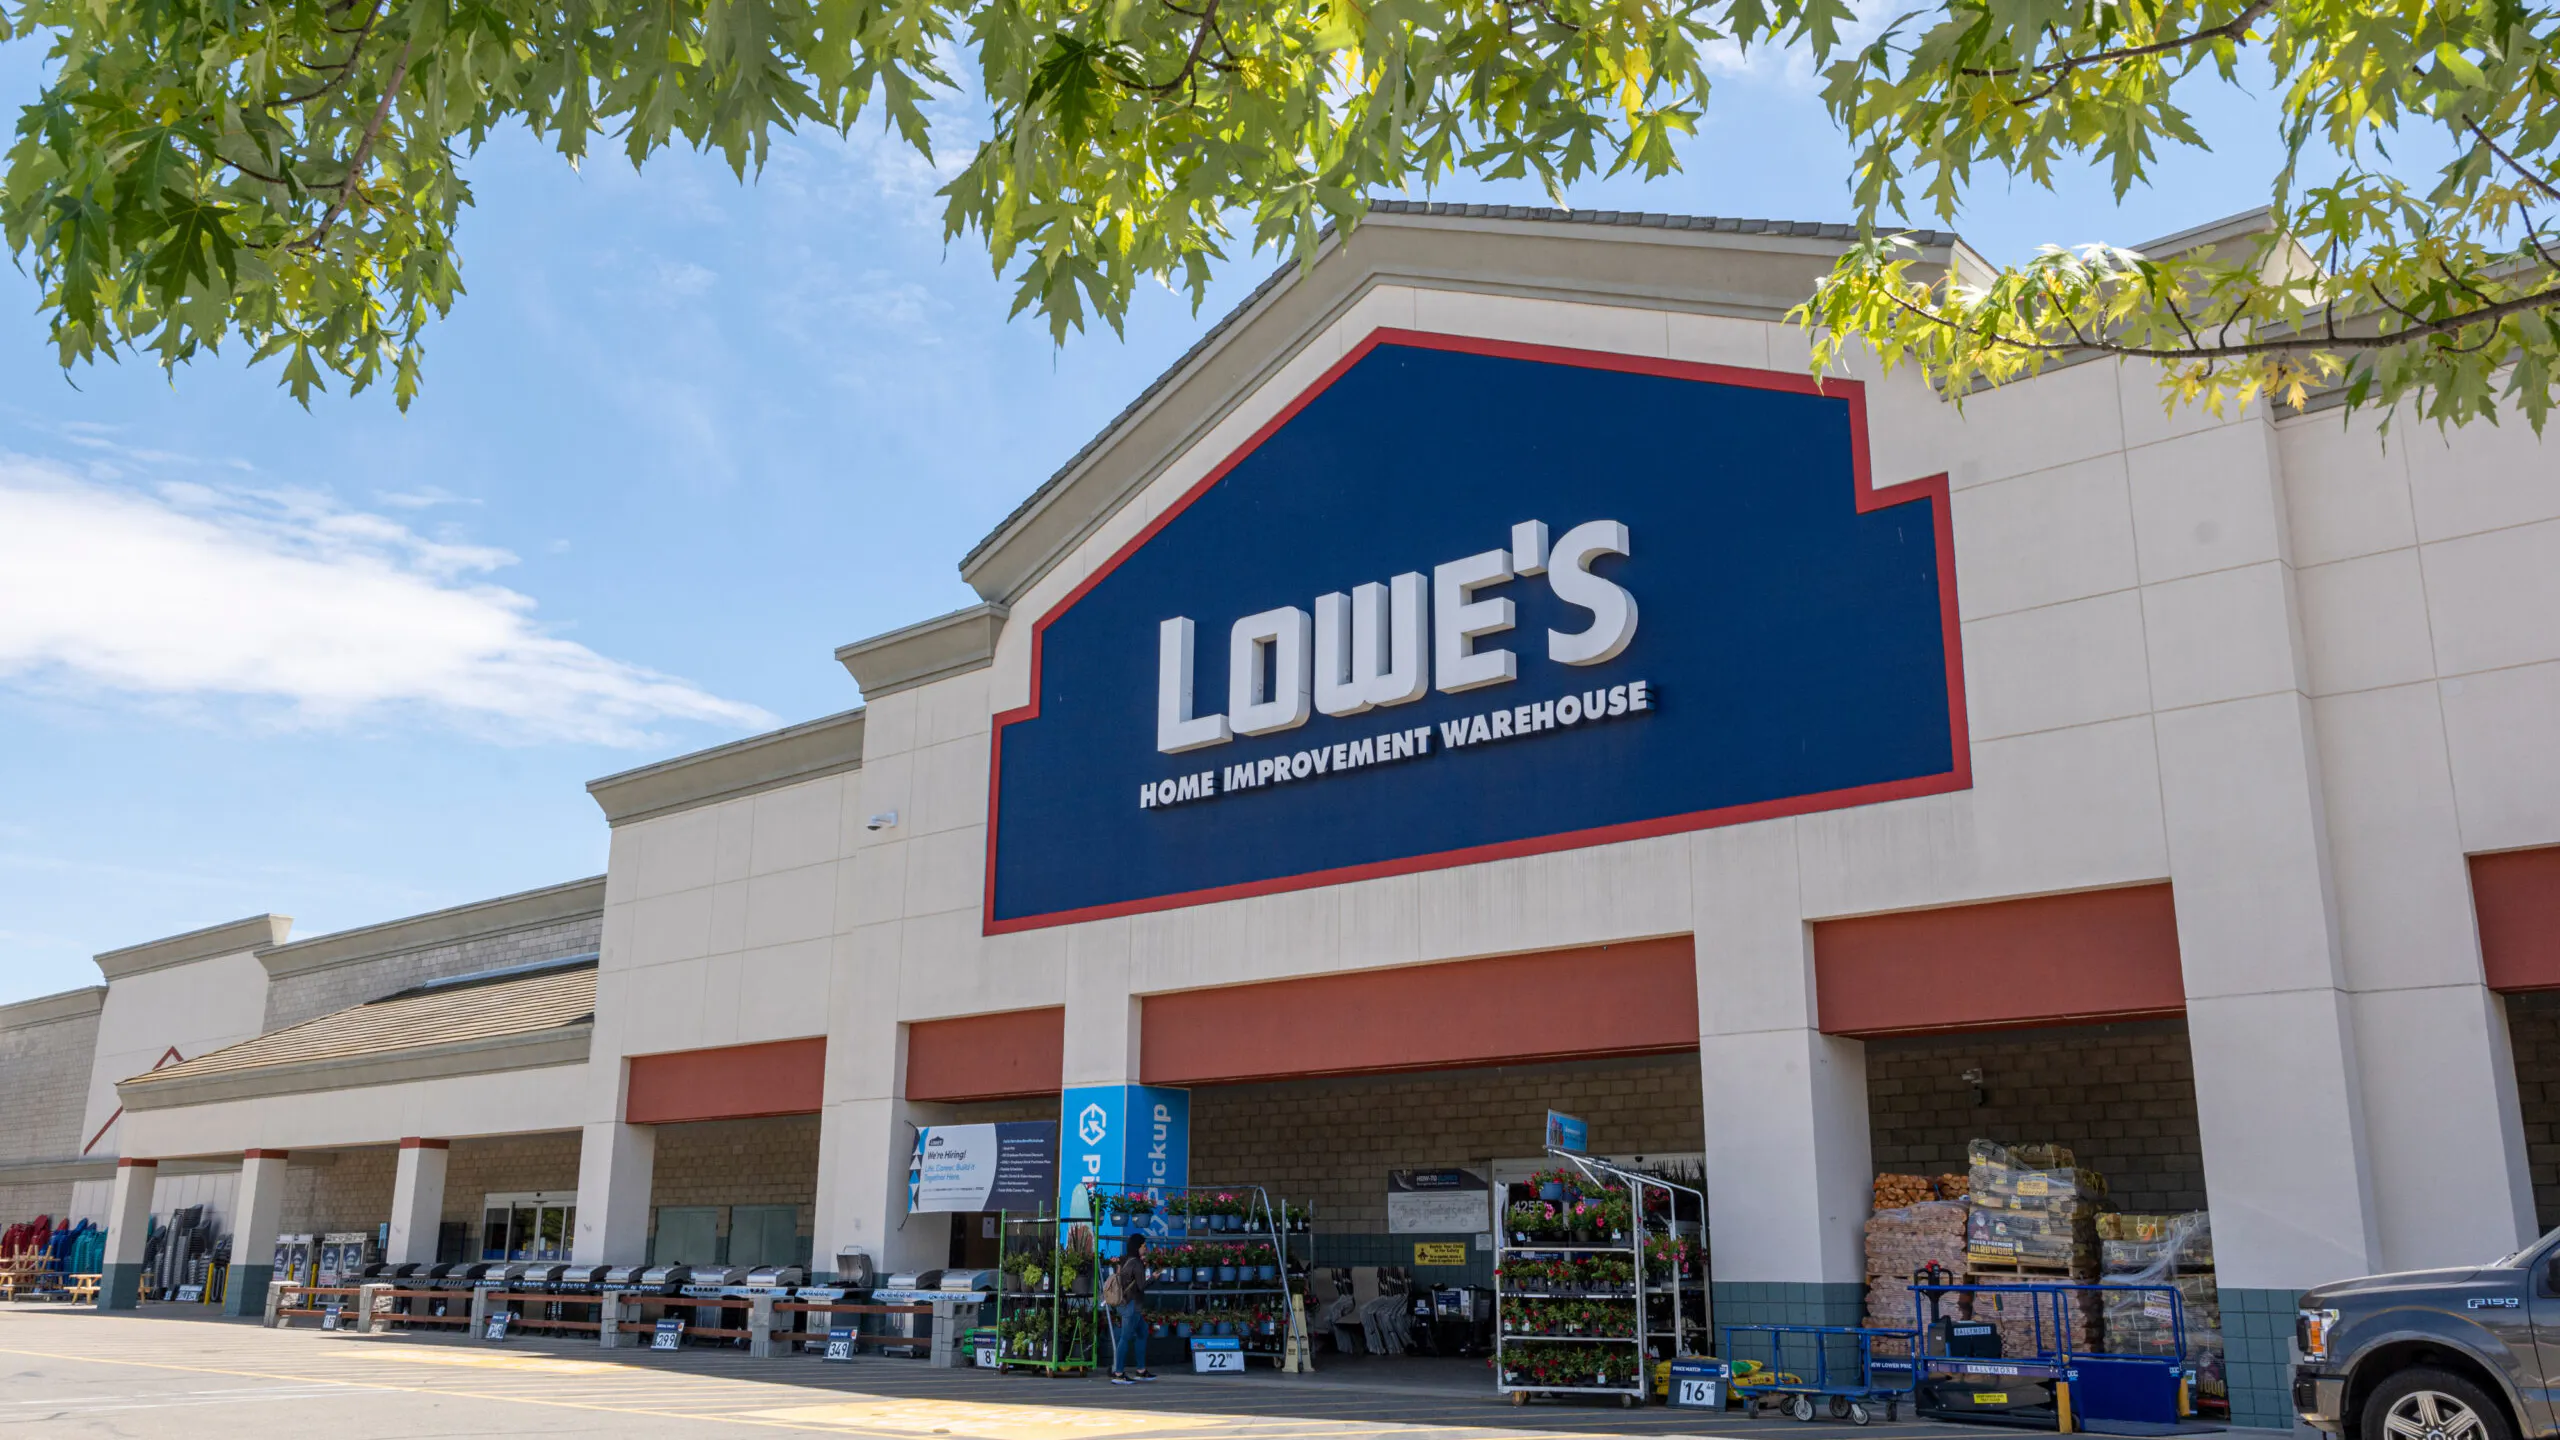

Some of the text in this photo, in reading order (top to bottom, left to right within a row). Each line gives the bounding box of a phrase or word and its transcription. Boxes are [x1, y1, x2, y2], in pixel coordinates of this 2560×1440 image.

[1157, 519, 1639, 754] LOWE'S
[1140, 680, 1648, 809] HOME IMPROVEMENT WAREHOUSE
[945, 1150, 967, 1161] Hiring!
[1970, 1365, 2017, 1375] BALLYMORE
